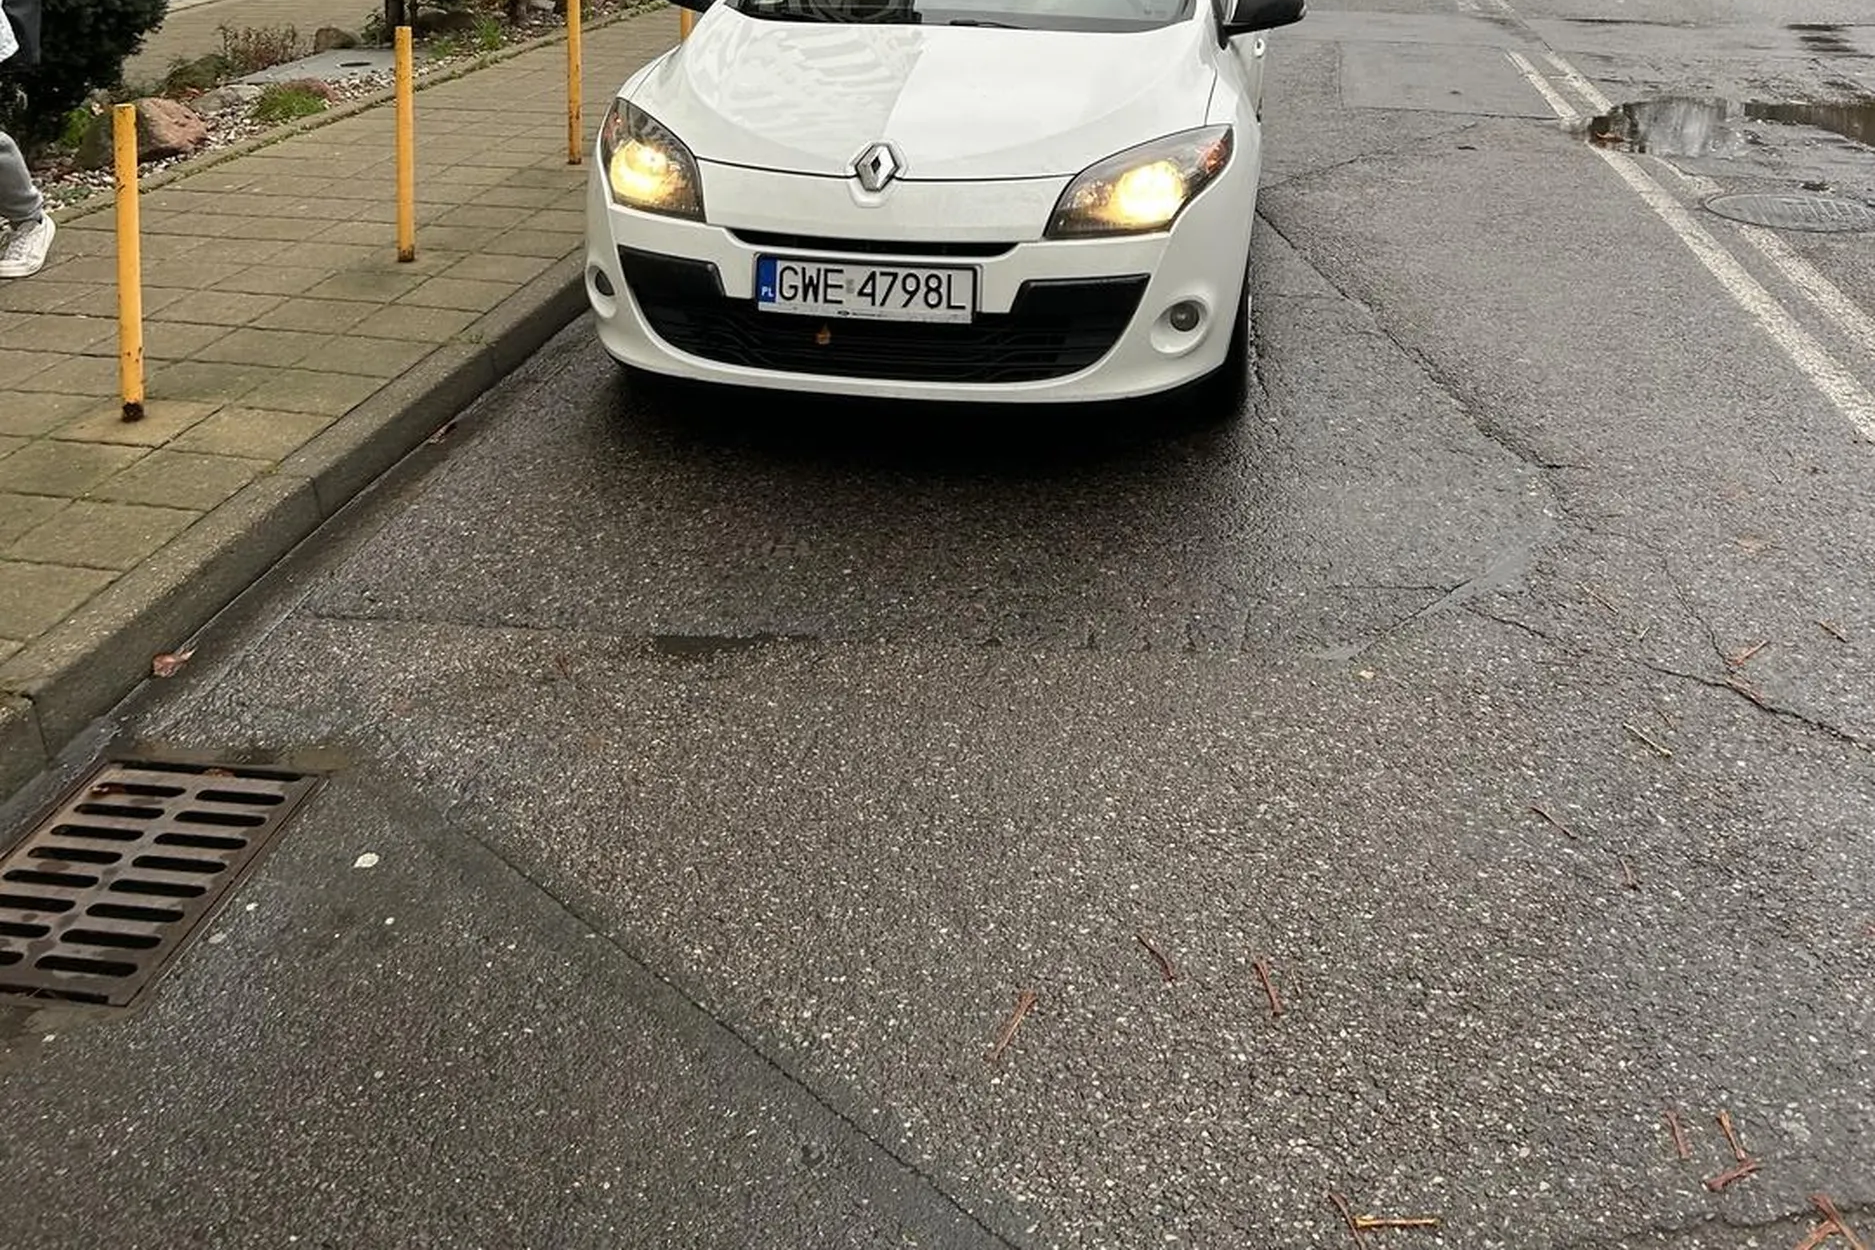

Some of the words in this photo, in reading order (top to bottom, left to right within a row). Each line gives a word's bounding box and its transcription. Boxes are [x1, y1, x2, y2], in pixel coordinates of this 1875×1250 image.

[761, 286, 775, 298] PL
[779, 265, 844, 305] GWE
[857, 270, 966, 310] 4798L
